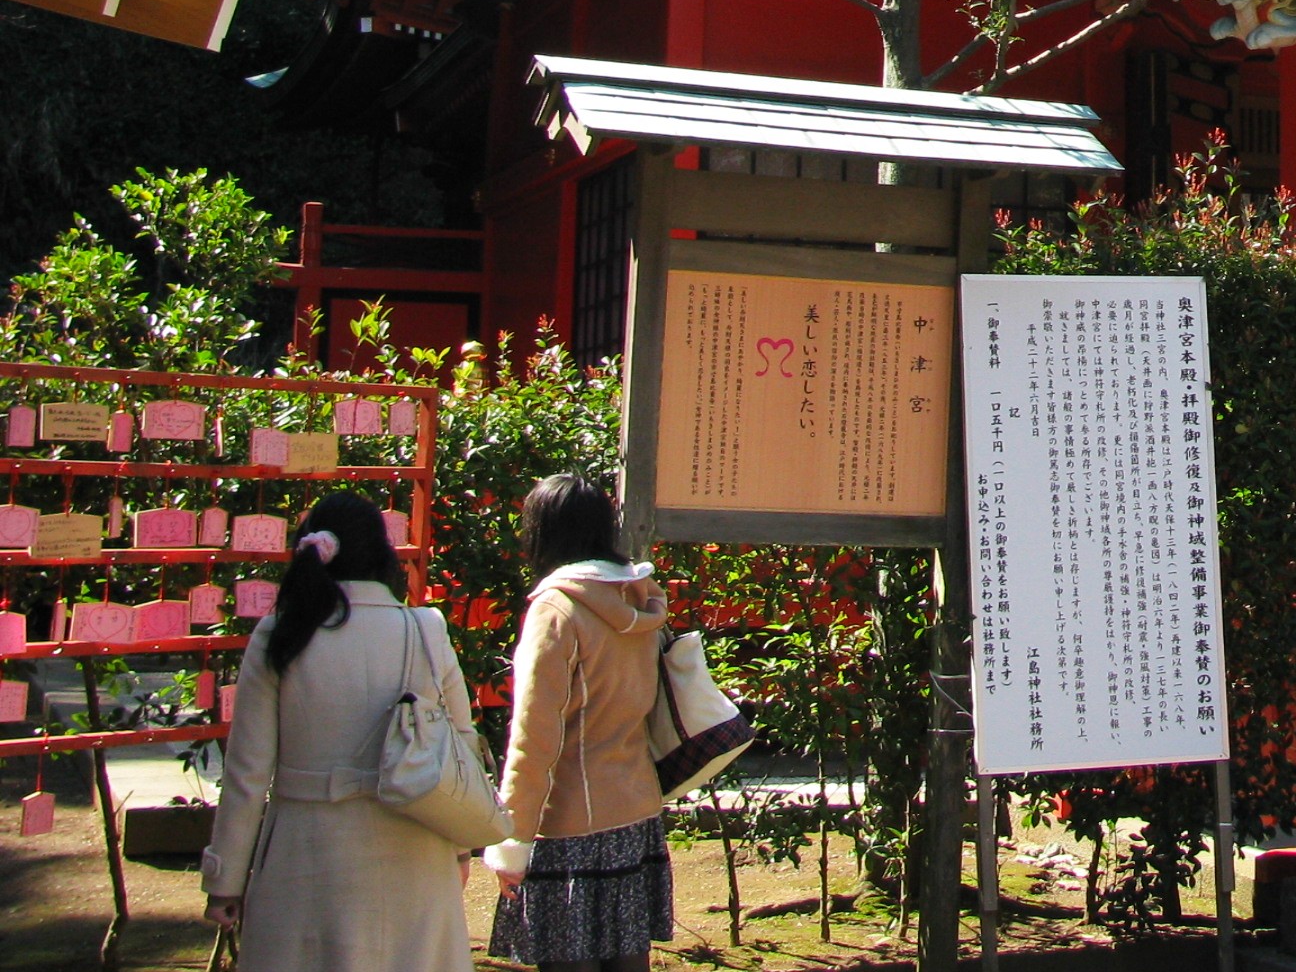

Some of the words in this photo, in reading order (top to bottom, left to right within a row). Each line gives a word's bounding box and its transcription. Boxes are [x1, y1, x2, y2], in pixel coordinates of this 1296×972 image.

[800, 304, 820, 439] 美しい恋したい。
[909, 316, 929, 414] 中津宮
[1008, 406, 1020, 418] 記
[1026, 323, 1040, 437] 平成二十二年六月吉日
[1176, 296, 1216, 736] 奥津宮本殿・拝殿御修復及御神域整備事業御奉賛のお願い
[976, 473, 996, 695] お申込み・お問い合わせは社務所まで
[1026, 646, 1044, 751] 江島神社社務所
